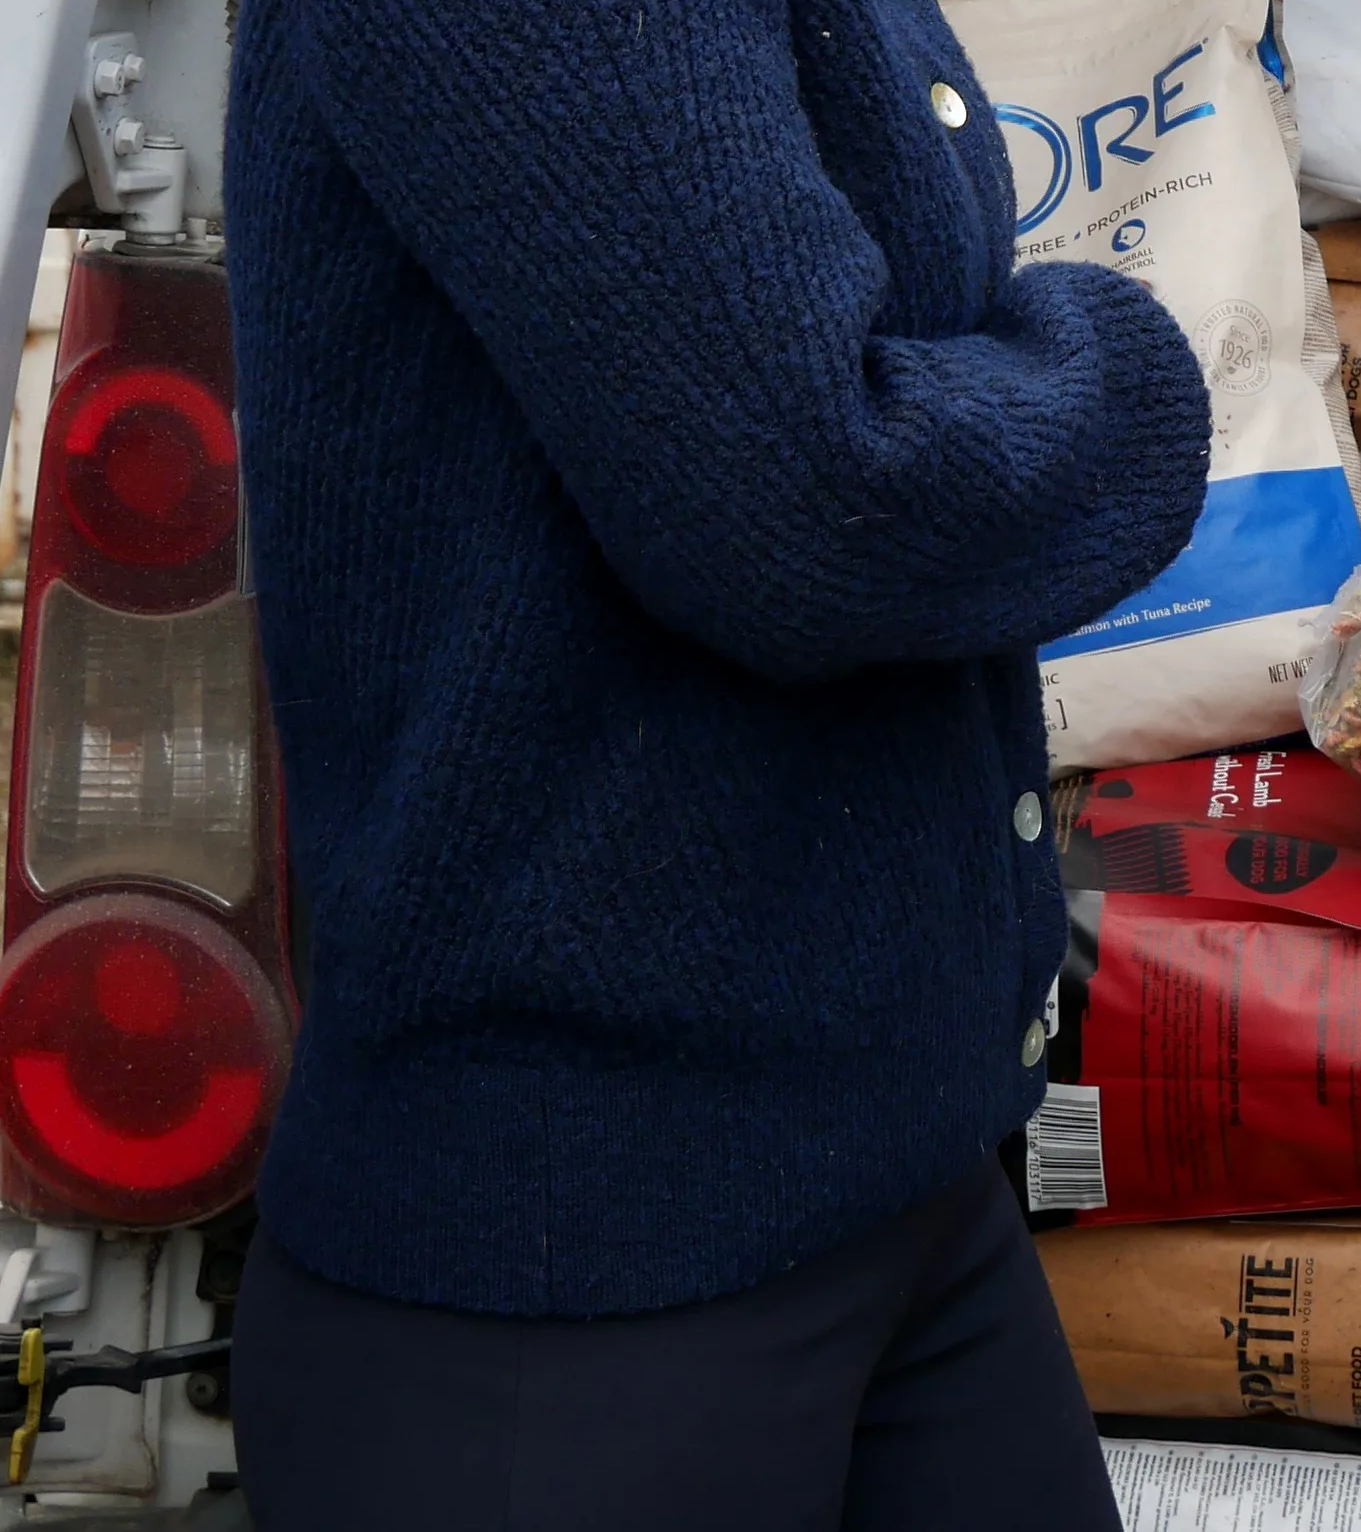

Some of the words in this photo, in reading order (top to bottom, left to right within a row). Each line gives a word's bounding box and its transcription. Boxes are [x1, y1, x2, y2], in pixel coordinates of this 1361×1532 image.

[1087, 171, 1214, 236] PROTEIN-RICH
[1234, 304, 1263, 330] NATURAL
[1219, 339, 1254, 369] 1926
[1112, 612, 1139, 629] with
[1141, 606, 1171, 621] Tuna
[1173, 597, 1211, 614] Recipe
[1268, 664, 1288, 684] NET
[1212, 753, 1241, 792] without
[1252, 771, 1282, 807] Lamb
[1028, 1157, 1041, 1201] 103117
[1303, 1257, 1314, 1284] DOG
[1300, 1290, 1312, 1323] YOUR
[1300, 1329, 1310, 1353] FOR
[1298, 1358, 1310, 1390] GOOD
